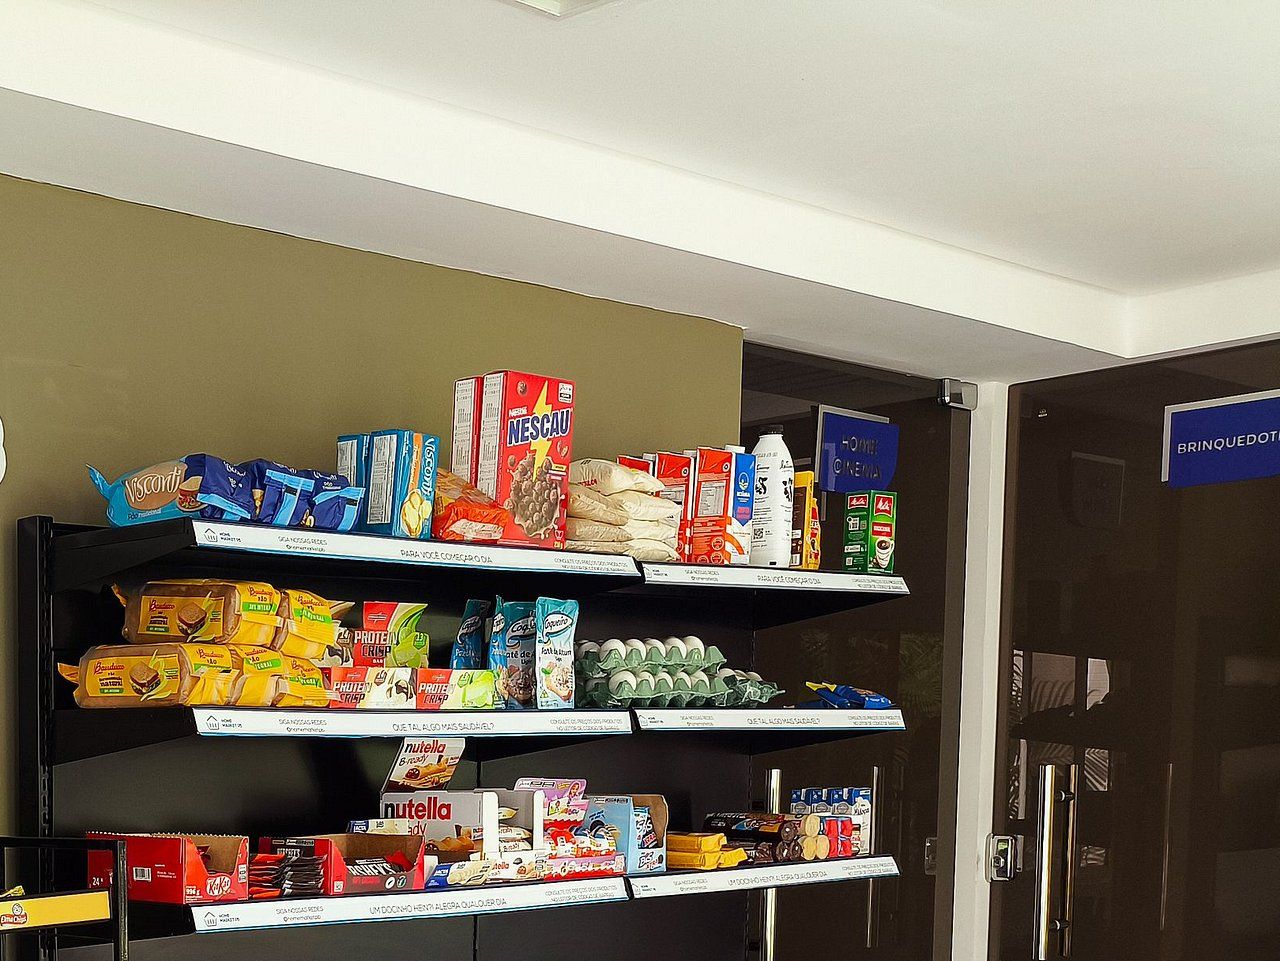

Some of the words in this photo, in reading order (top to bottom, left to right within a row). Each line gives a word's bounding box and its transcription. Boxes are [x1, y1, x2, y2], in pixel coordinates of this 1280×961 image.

[507, 410, 571, 447] NESCAU
[833, 459, 882, 480] CINEMA
[125, 467, 181, 503] Visconti
[400, 550, 419, 558] PARA
[420, 550, 440, 560] VOCÊ
[354, 631, 397, 645] PROTEIN
[362, 645, 391, 658] CRISP
[333, 682, 372, 693] PROTEIN
[418, 683, 454, 694] PROTEIN
[423, 694, 448, 704] CRISP
[392, 723, 408, 732] QUE
[408, 723, 422, 731] TAL
[422, 723, 442, 731] ALGO
[404, 739, 446, 753] nutella
[384, 796, 451, 821] nutella
